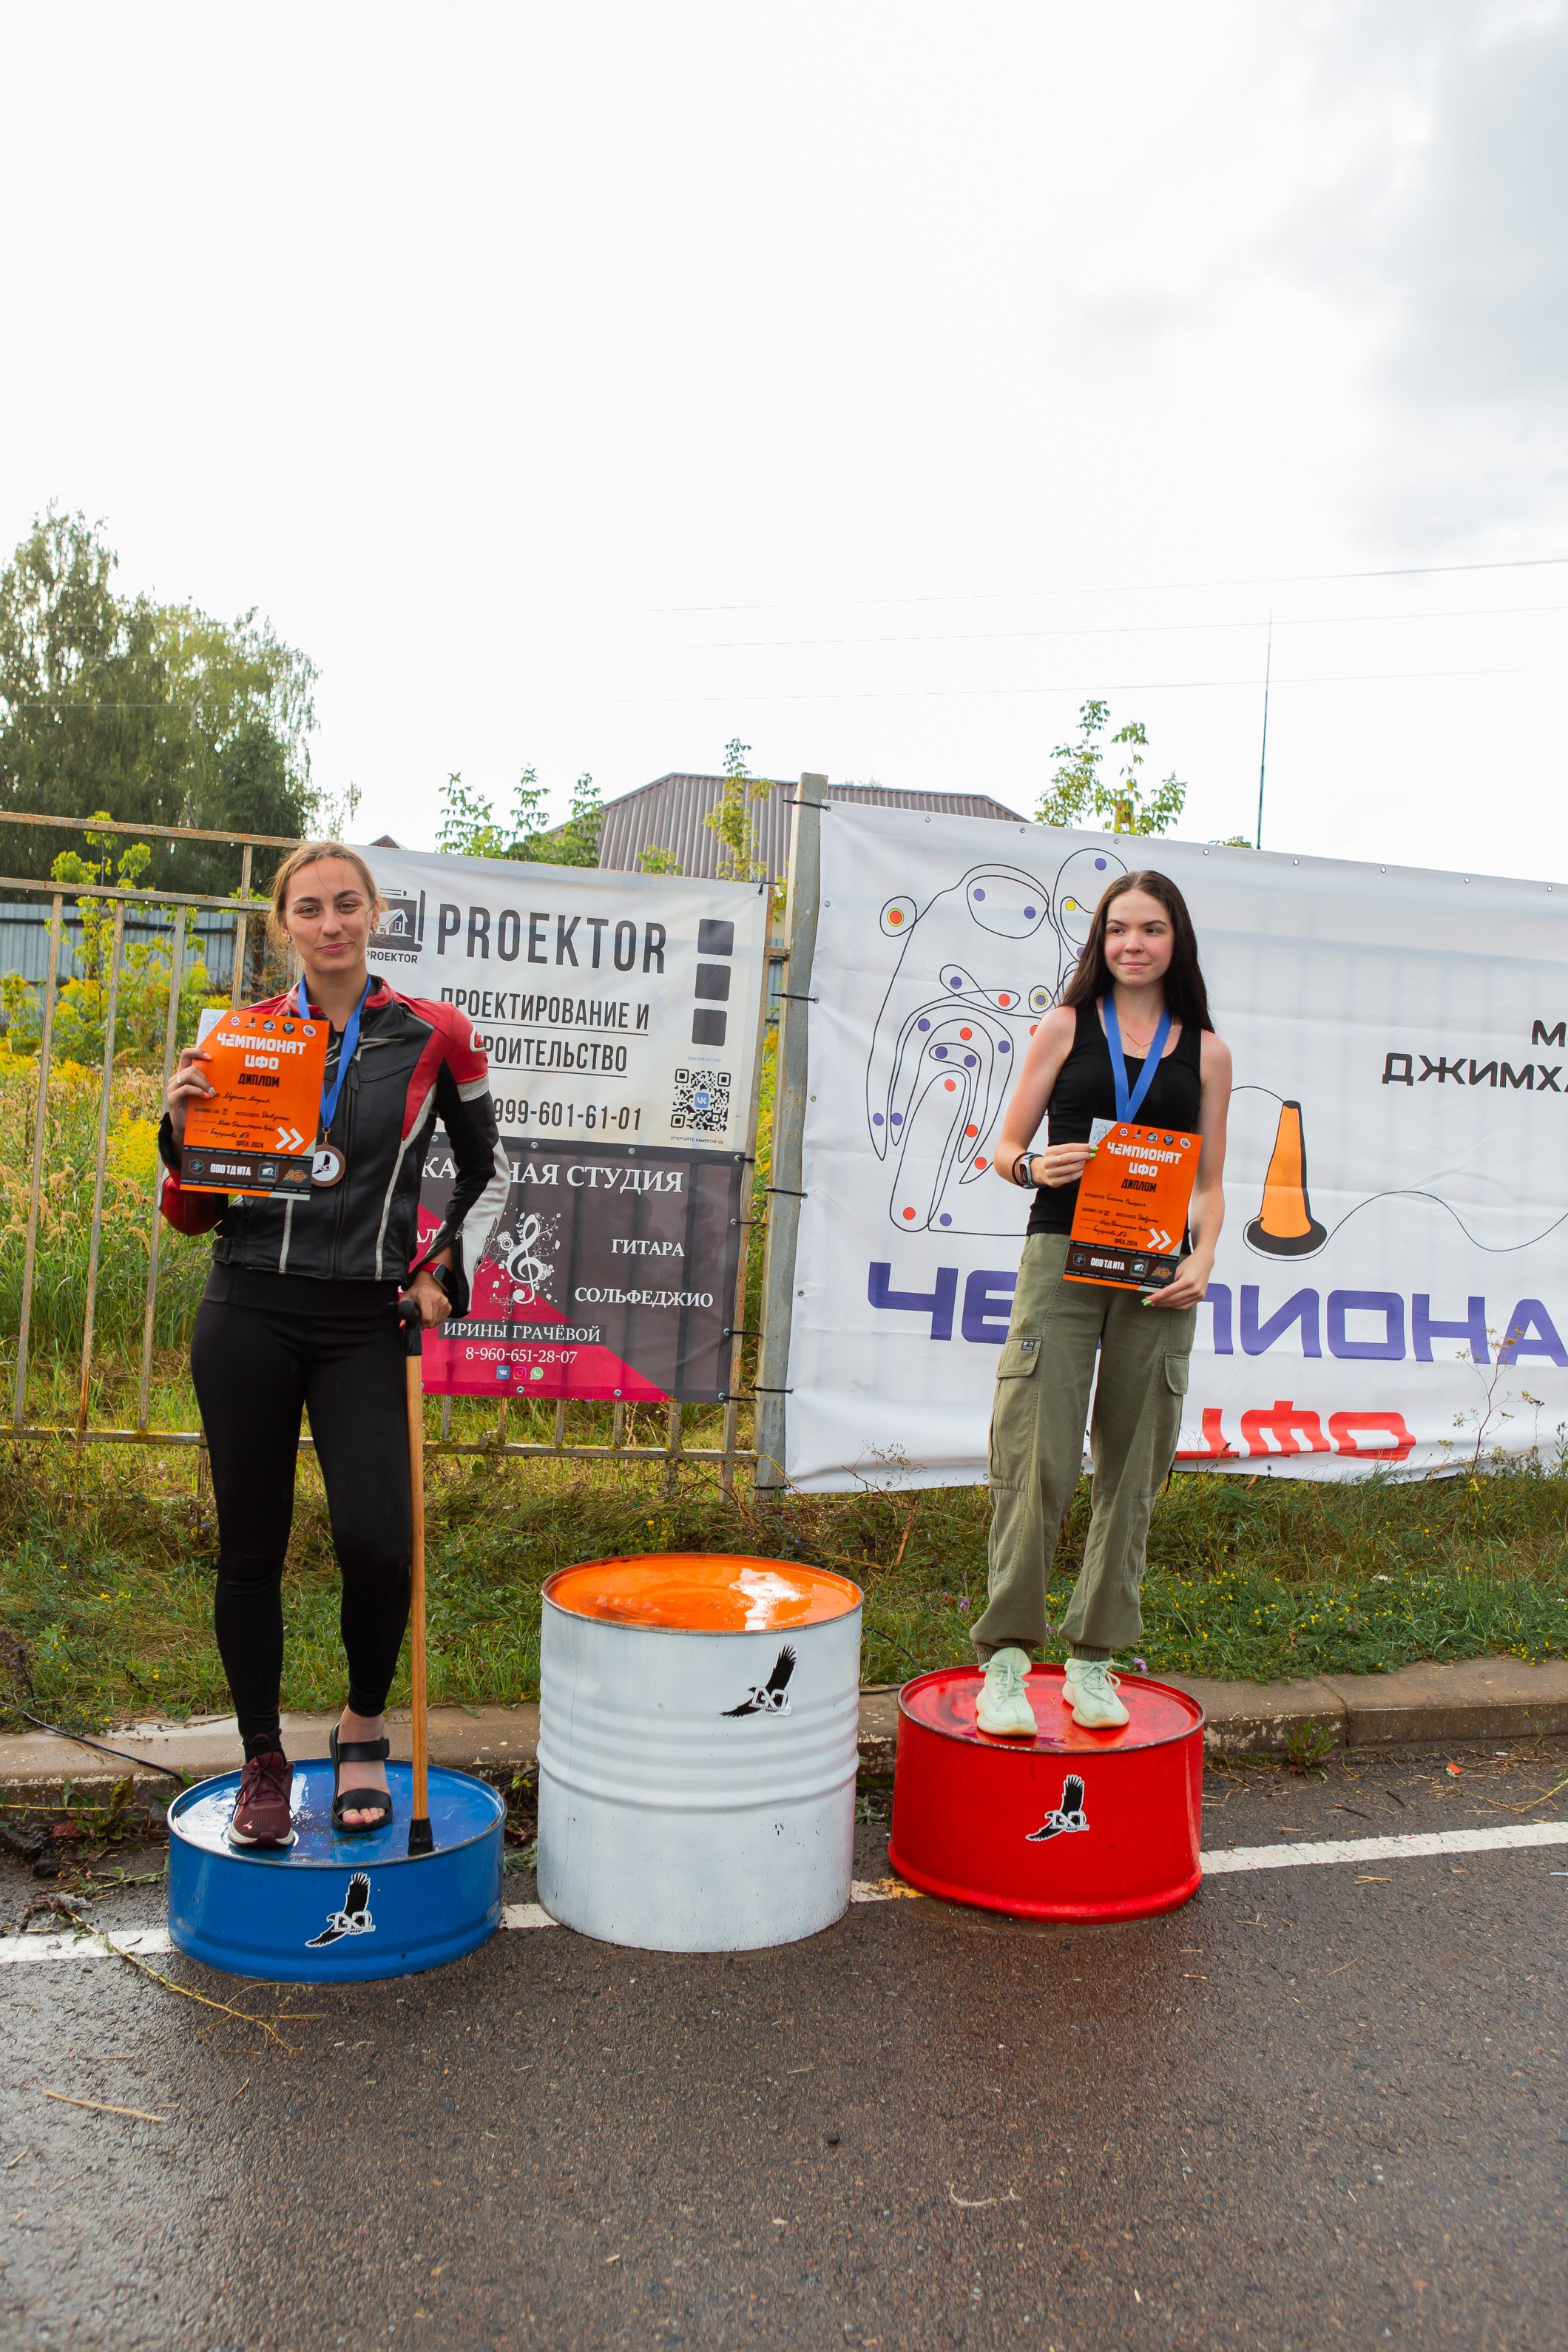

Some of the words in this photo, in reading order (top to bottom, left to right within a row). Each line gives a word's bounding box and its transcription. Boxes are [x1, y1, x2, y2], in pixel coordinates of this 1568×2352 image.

[437, 903, 666, 974] PROEKTOR
[442, 987, 629, 1029] ПРОЕКТИРОВАНИЕ
[636, 1003, 649, 1030] И
[1531, 1019, 1568, 1047] М
[217, 1032, 307, 1055] ЧЕМПИОНАТ
[483, 1035, 628, 1072] РОИТЕЛЬСТВО
[244, 1055, 280, 1070] ЦФО
[1382, 1052, 1568, 1093] ДЖИМХ
[237, 1072, 280, 1088] ДИПЛОМ
[1106, 1141, 1182, 1165] ЧЕМПИОНАТ
[210, 1163, 226, 1174] ООО
[226, 1165, 236, 1175] ТД
[237, 1166, 251, 1176] ИТА
[567, 1165, 684, 1194] СТУДИЯ
[1128, 1162, 1158, 1177] ЦФО
[1121, 1178, 1158, 1193] ДИПЛОМ
[611, 1239, 686, 1257] ГИТАРА
[1090, 1257, 1102, 1268] ООО
[1103, 1260, 1112, 1269] ТД
[1112, 1260, 1124, 1271] ИТА
[575, 1287, 714, 1308] СОЛЬФЕДЖИО
[444, 1322, 507, 1338] ИРИНЫ
[512, 1324, 601, 1342] ГРАЧЁВОЙ
[465, 1346, 578, 1364] 8-960-651-28-07
